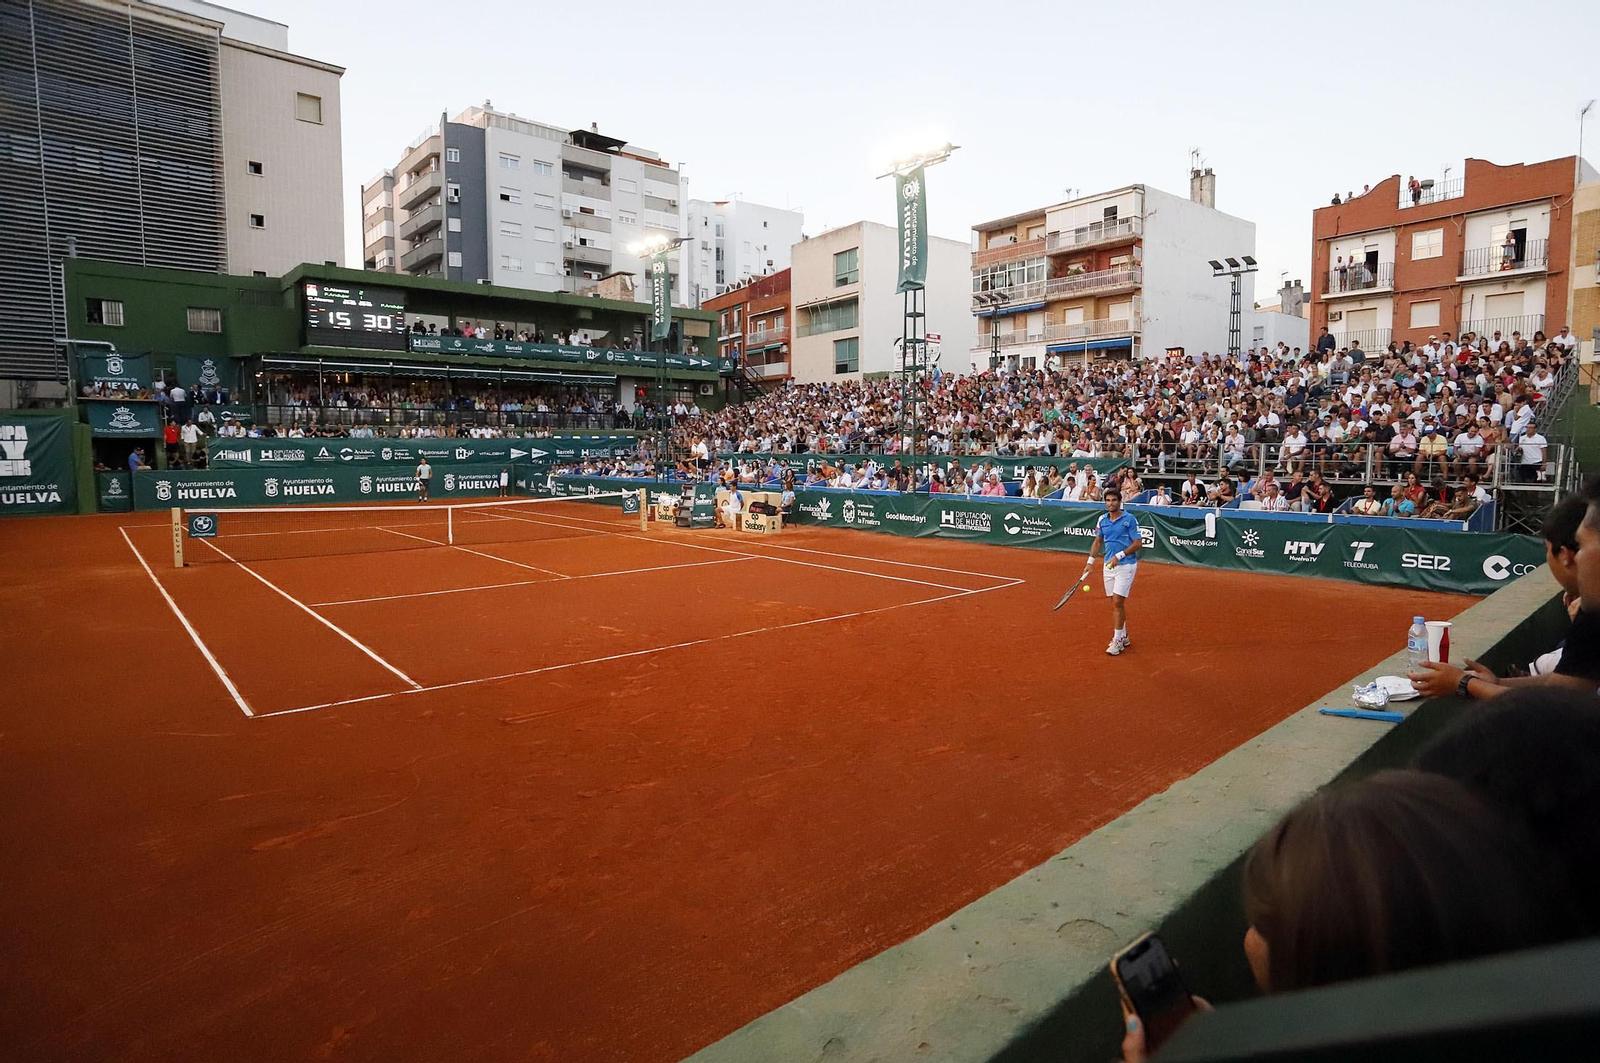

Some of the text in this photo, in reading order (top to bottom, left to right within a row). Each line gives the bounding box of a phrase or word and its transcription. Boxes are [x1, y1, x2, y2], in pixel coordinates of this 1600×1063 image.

[912, 256, 918, 265] de
[328, 311, 351, 326] 15
[363, 314, 391, 329] 30
[284, 485, 335, 496] HUELVA
[377, 483, 420, 492] HUELVA
[459, 481, 499, 490] HUELVA
[178, 488, 237, 499] HUELVA
[799, 503, 822, 512] Fundación
[658, 512, 673, 520] Seaber
[862, 517, 880, 525] Frontera
[900, 513, 926, 523] Monday!
[942, 510, 954, 524] H
[956, 510, 991, 522] DIPUTACIÓN
[1022, 516, 1052, 527] Andalucía
[745, 520, 766, 533] Seabery
[966, 518, 991, 526] HUELVA
[1284, 541, 1325, 554] HTV
[1402, 553, 1451, 571] SER
